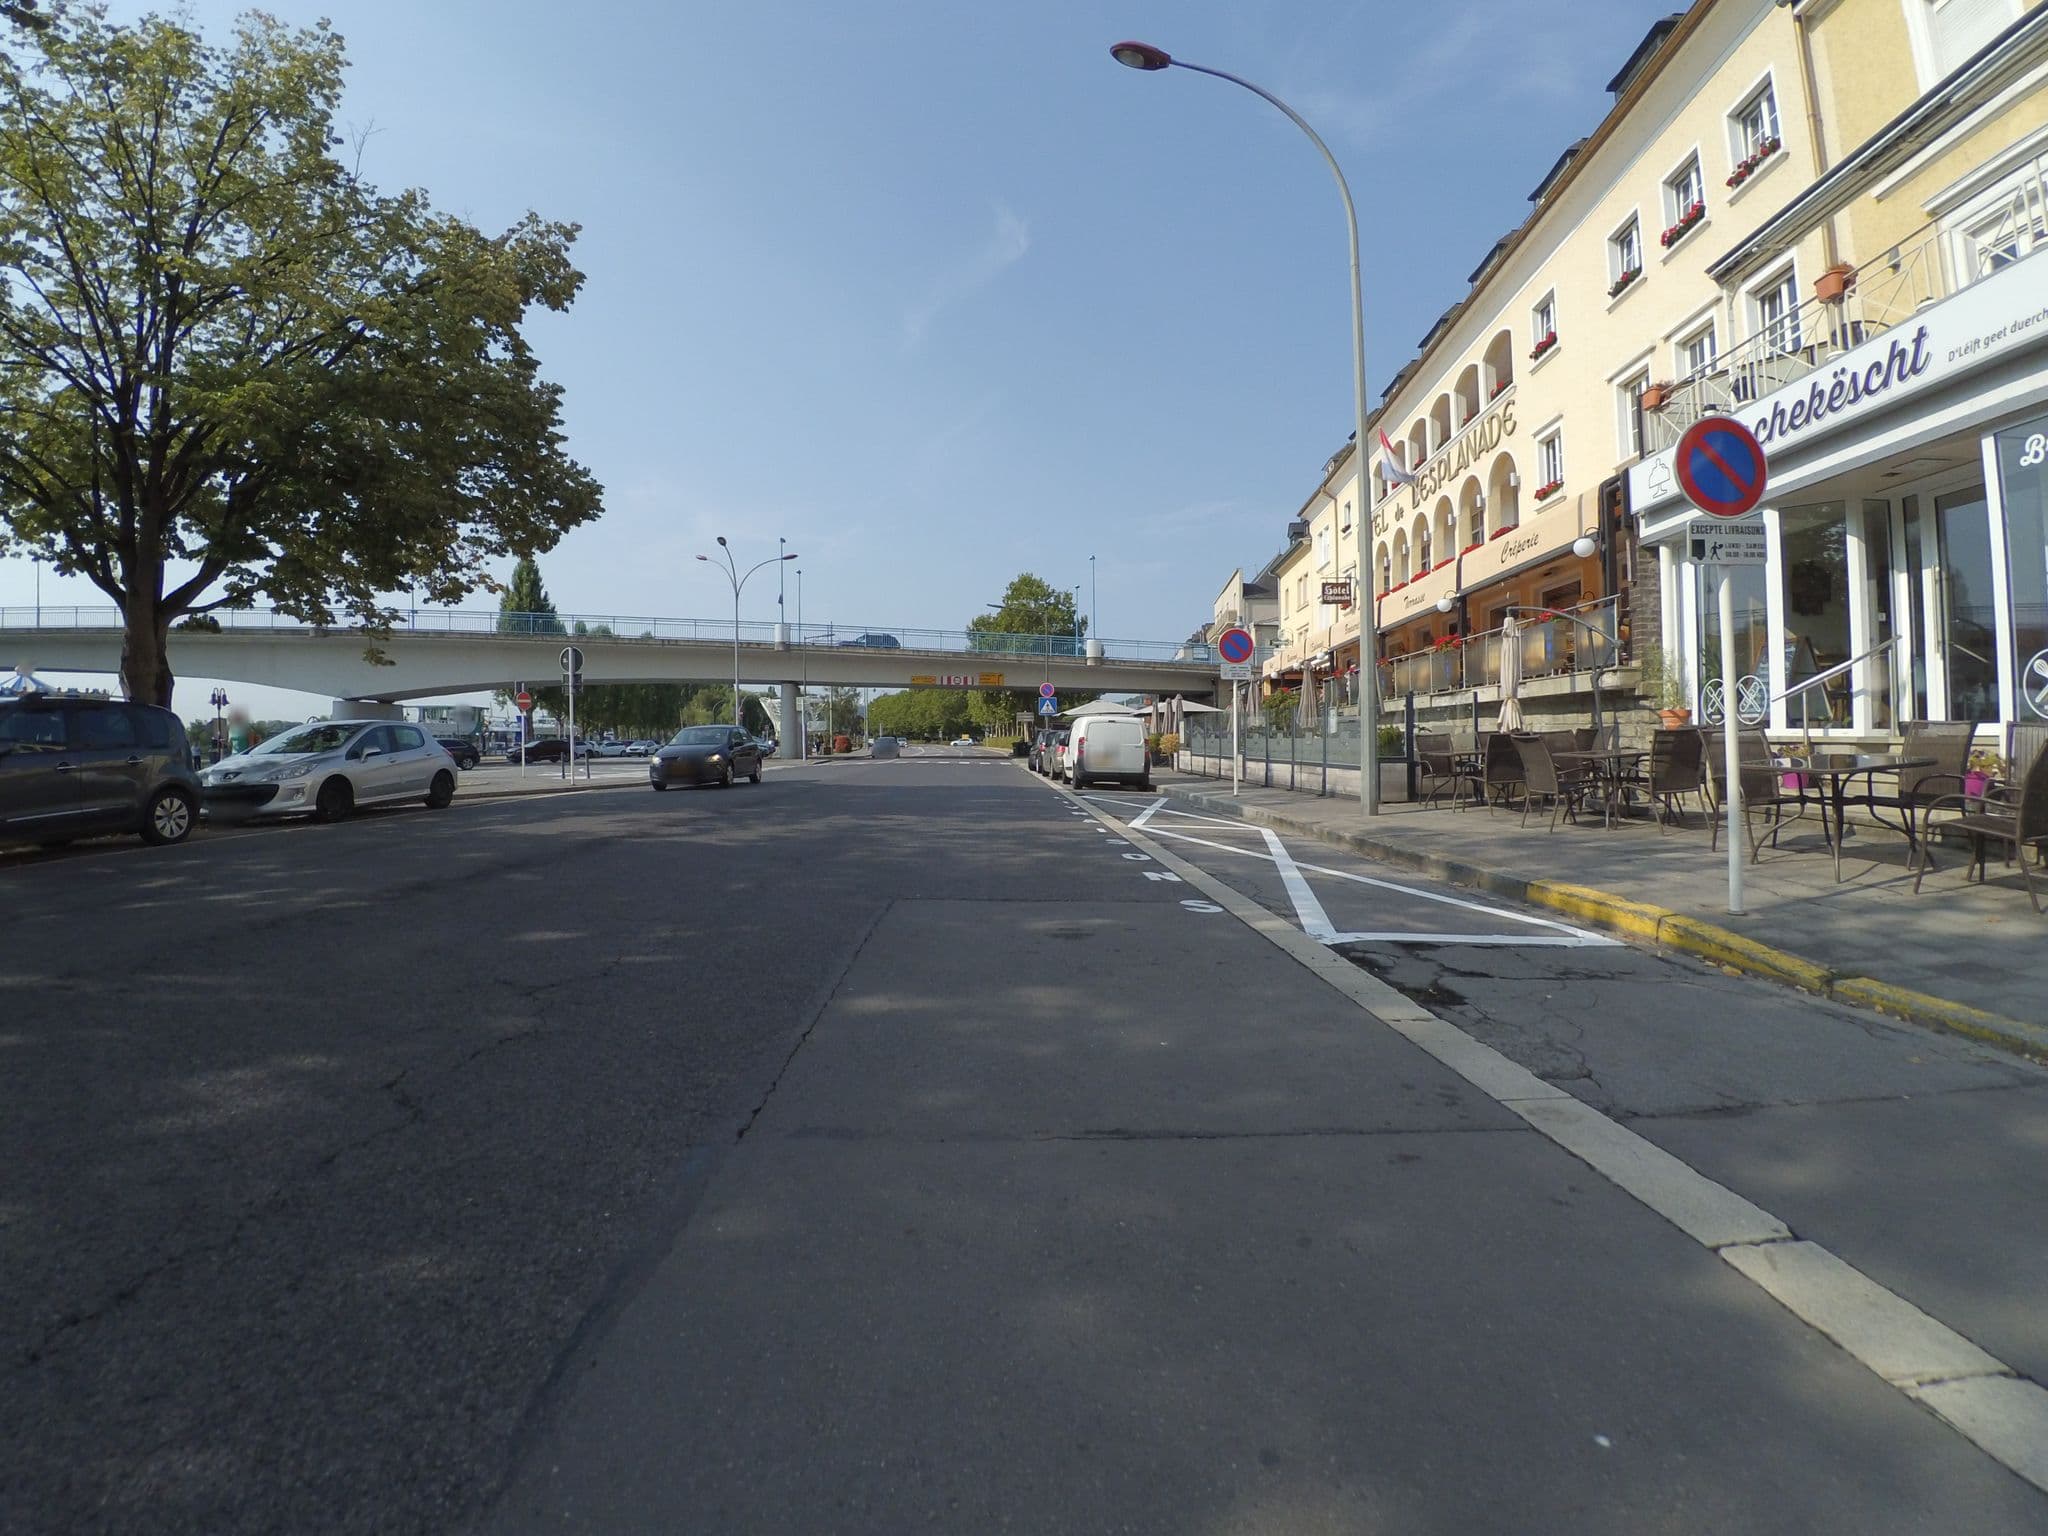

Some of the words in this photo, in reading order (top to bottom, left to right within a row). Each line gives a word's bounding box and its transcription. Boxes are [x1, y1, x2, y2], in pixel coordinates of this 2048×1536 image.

[1983, 326, 2007, 350] geet
[1745, 324, 1932, 445] chekëscht
[1372, 509, 1390, 537] EL
[1395, 502, 1405, 522] de
[1691, 524, 1723, 535] EXCEPTE
